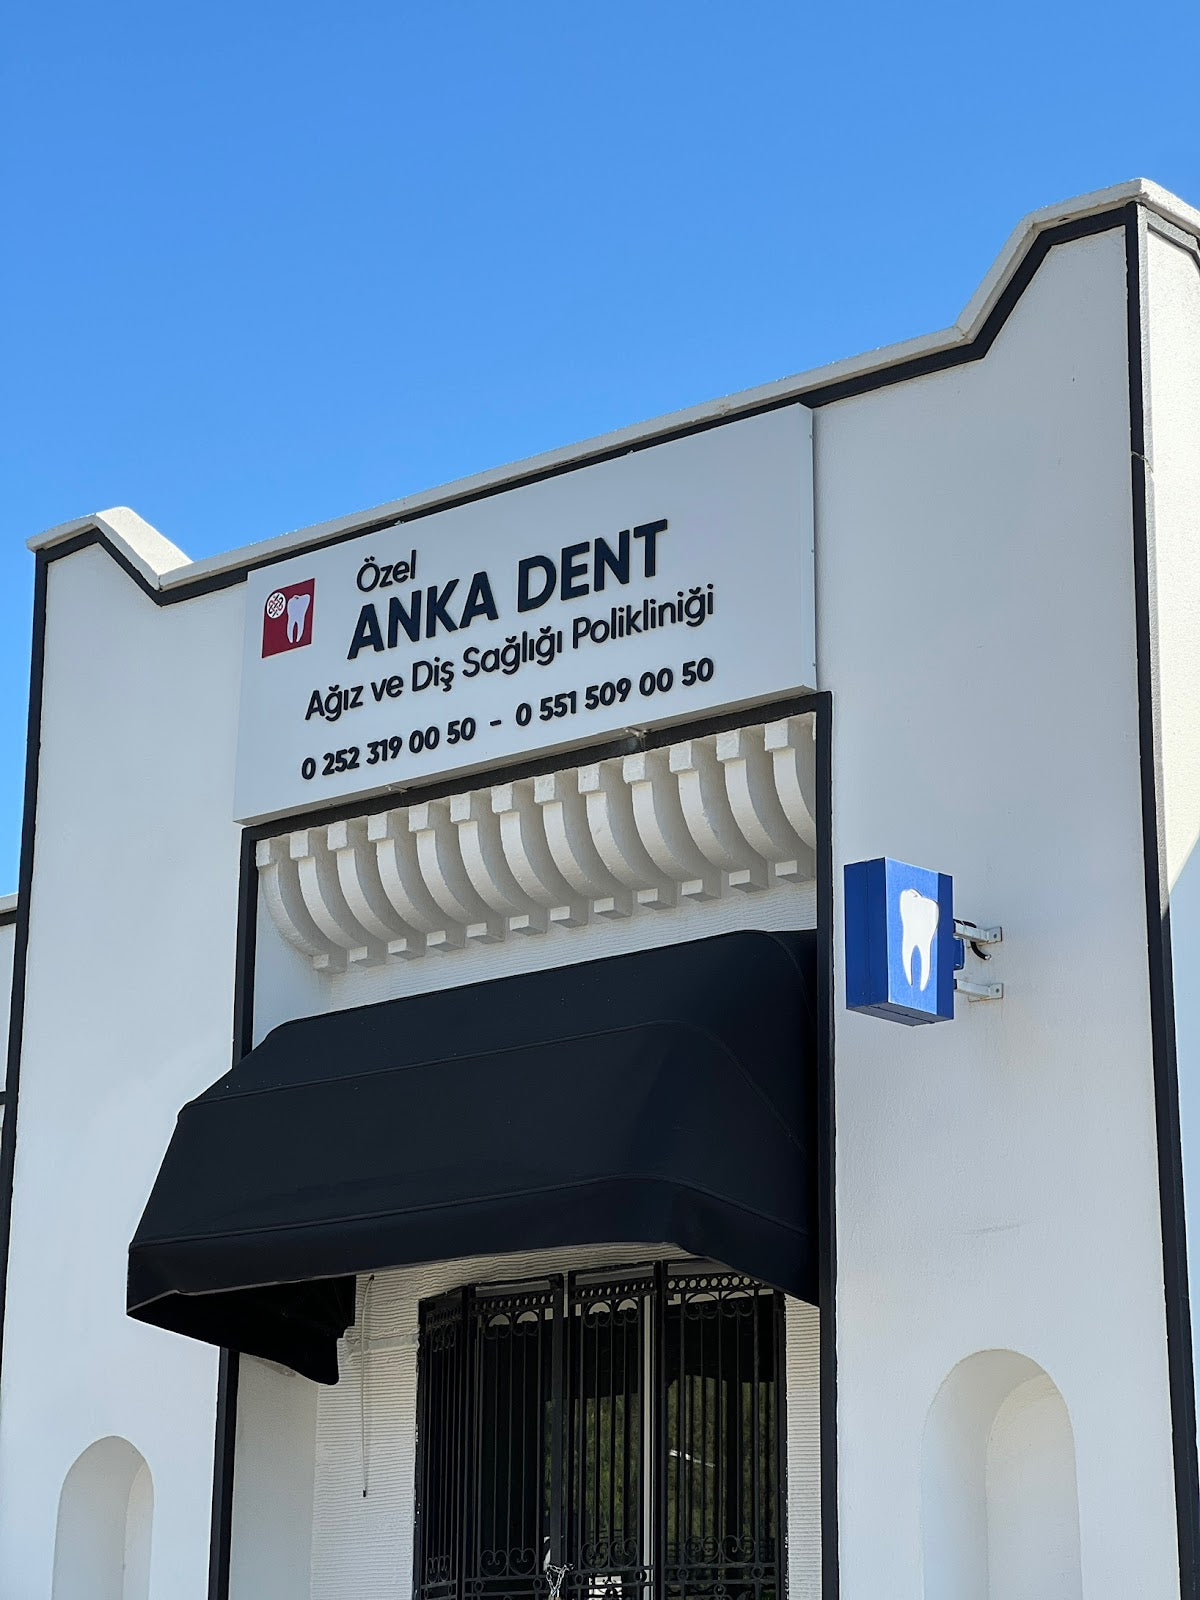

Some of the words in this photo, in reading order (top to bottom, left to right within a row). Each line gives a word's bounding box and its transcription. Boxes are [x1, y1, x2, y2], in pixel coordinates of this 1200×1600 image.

[346, 571, 500, 661] ANKA
[517, 518, 669, 614] DENT
[356, 549, 417, 593] Özel
[301, 757, 317, 781] 0
[321, 746, 361, 777] 252
[365, 735, 403, 765] 319
[408, 725, 441, 754] 00
[446, 716, 477, 745] 50
[515, 702, 533, 727] 0
[539, 690, 577, 722] 551
[584, 677, 632, 711] 509
[638, 667, 674, 697] 00
[681, 657, 715, 687] 50
[304, 684, 364, 723] Ağız
[370, 675, 404, 702] ve
[411, 656, 455, 693] Diş
[461, 625, 563, 677] Sağlığı
[572, 583, 714, 650] Polikliniği
